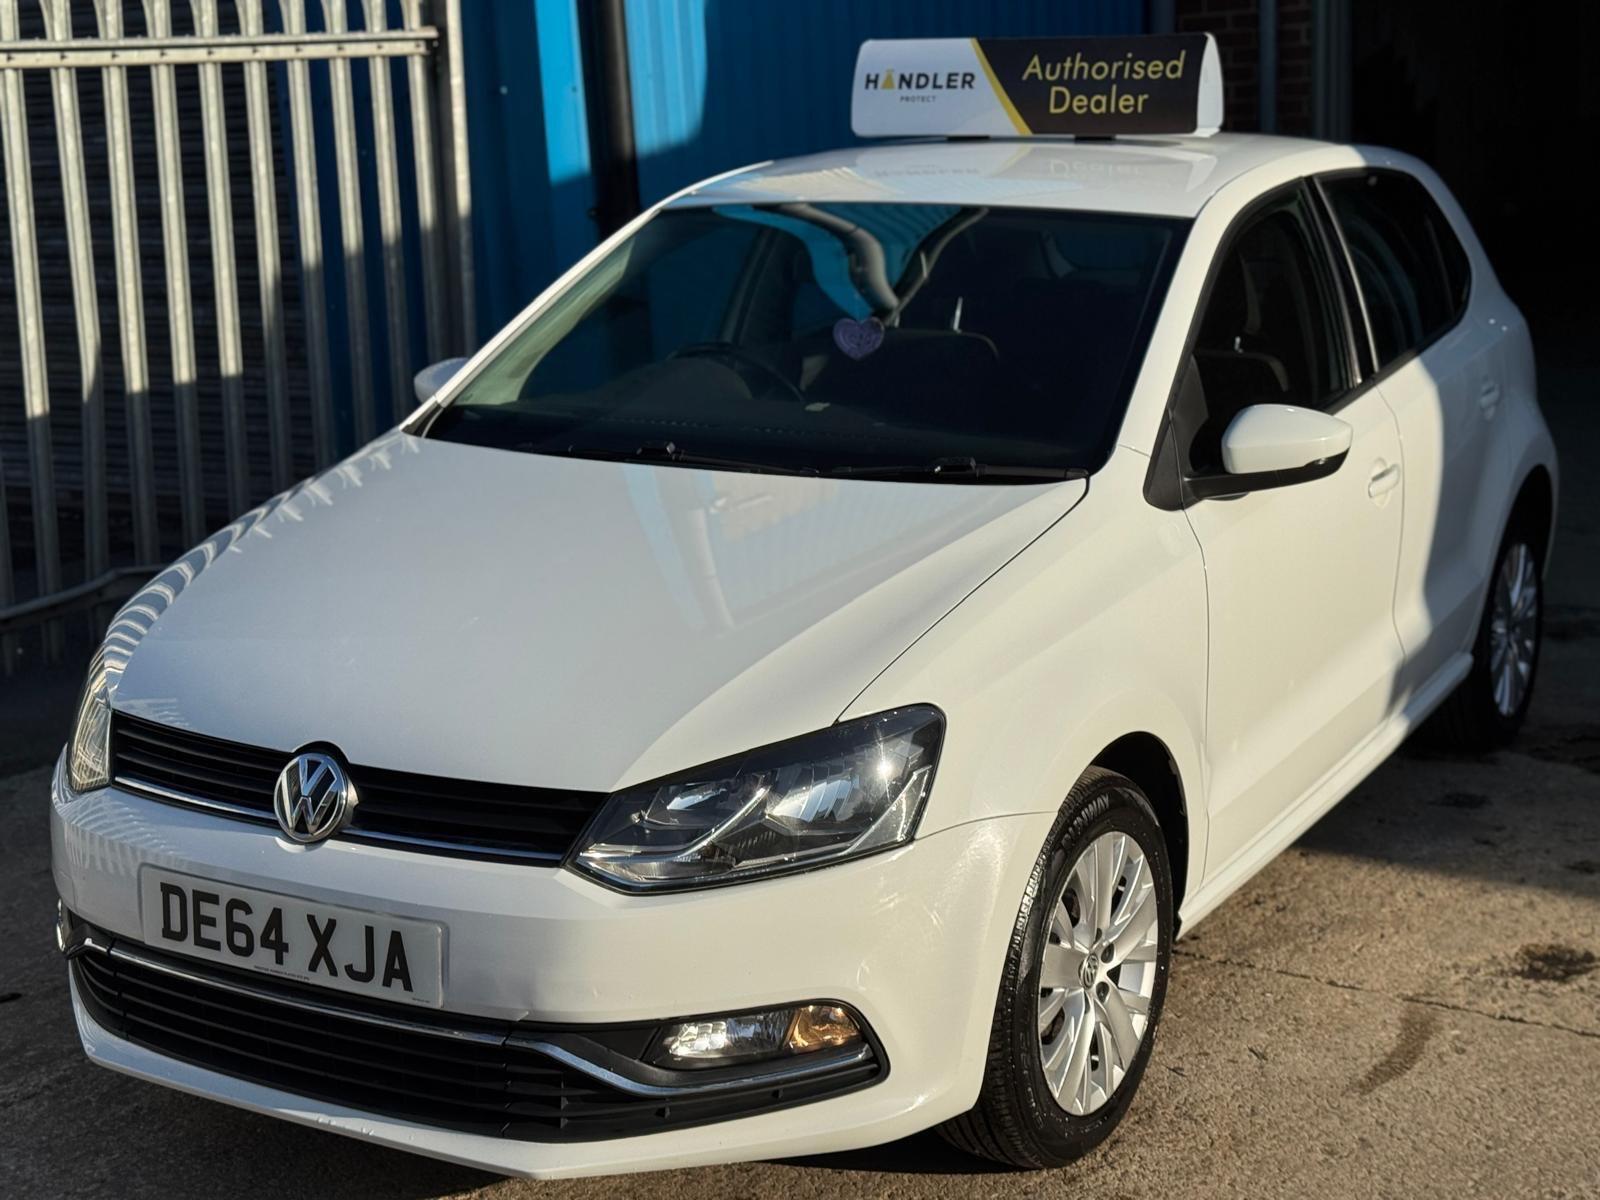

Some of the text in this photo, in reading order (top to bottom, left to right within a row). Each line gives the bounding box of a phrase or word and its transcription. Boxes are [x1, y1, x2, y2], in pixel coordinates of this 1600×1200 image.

[1022, 50, 1186, 80] Authorised
[900, 95, 936, 103] PROTECT
[1049, 84, 1149, 114] Dealer
[160, 881, 414, 993] DE64 XJA
